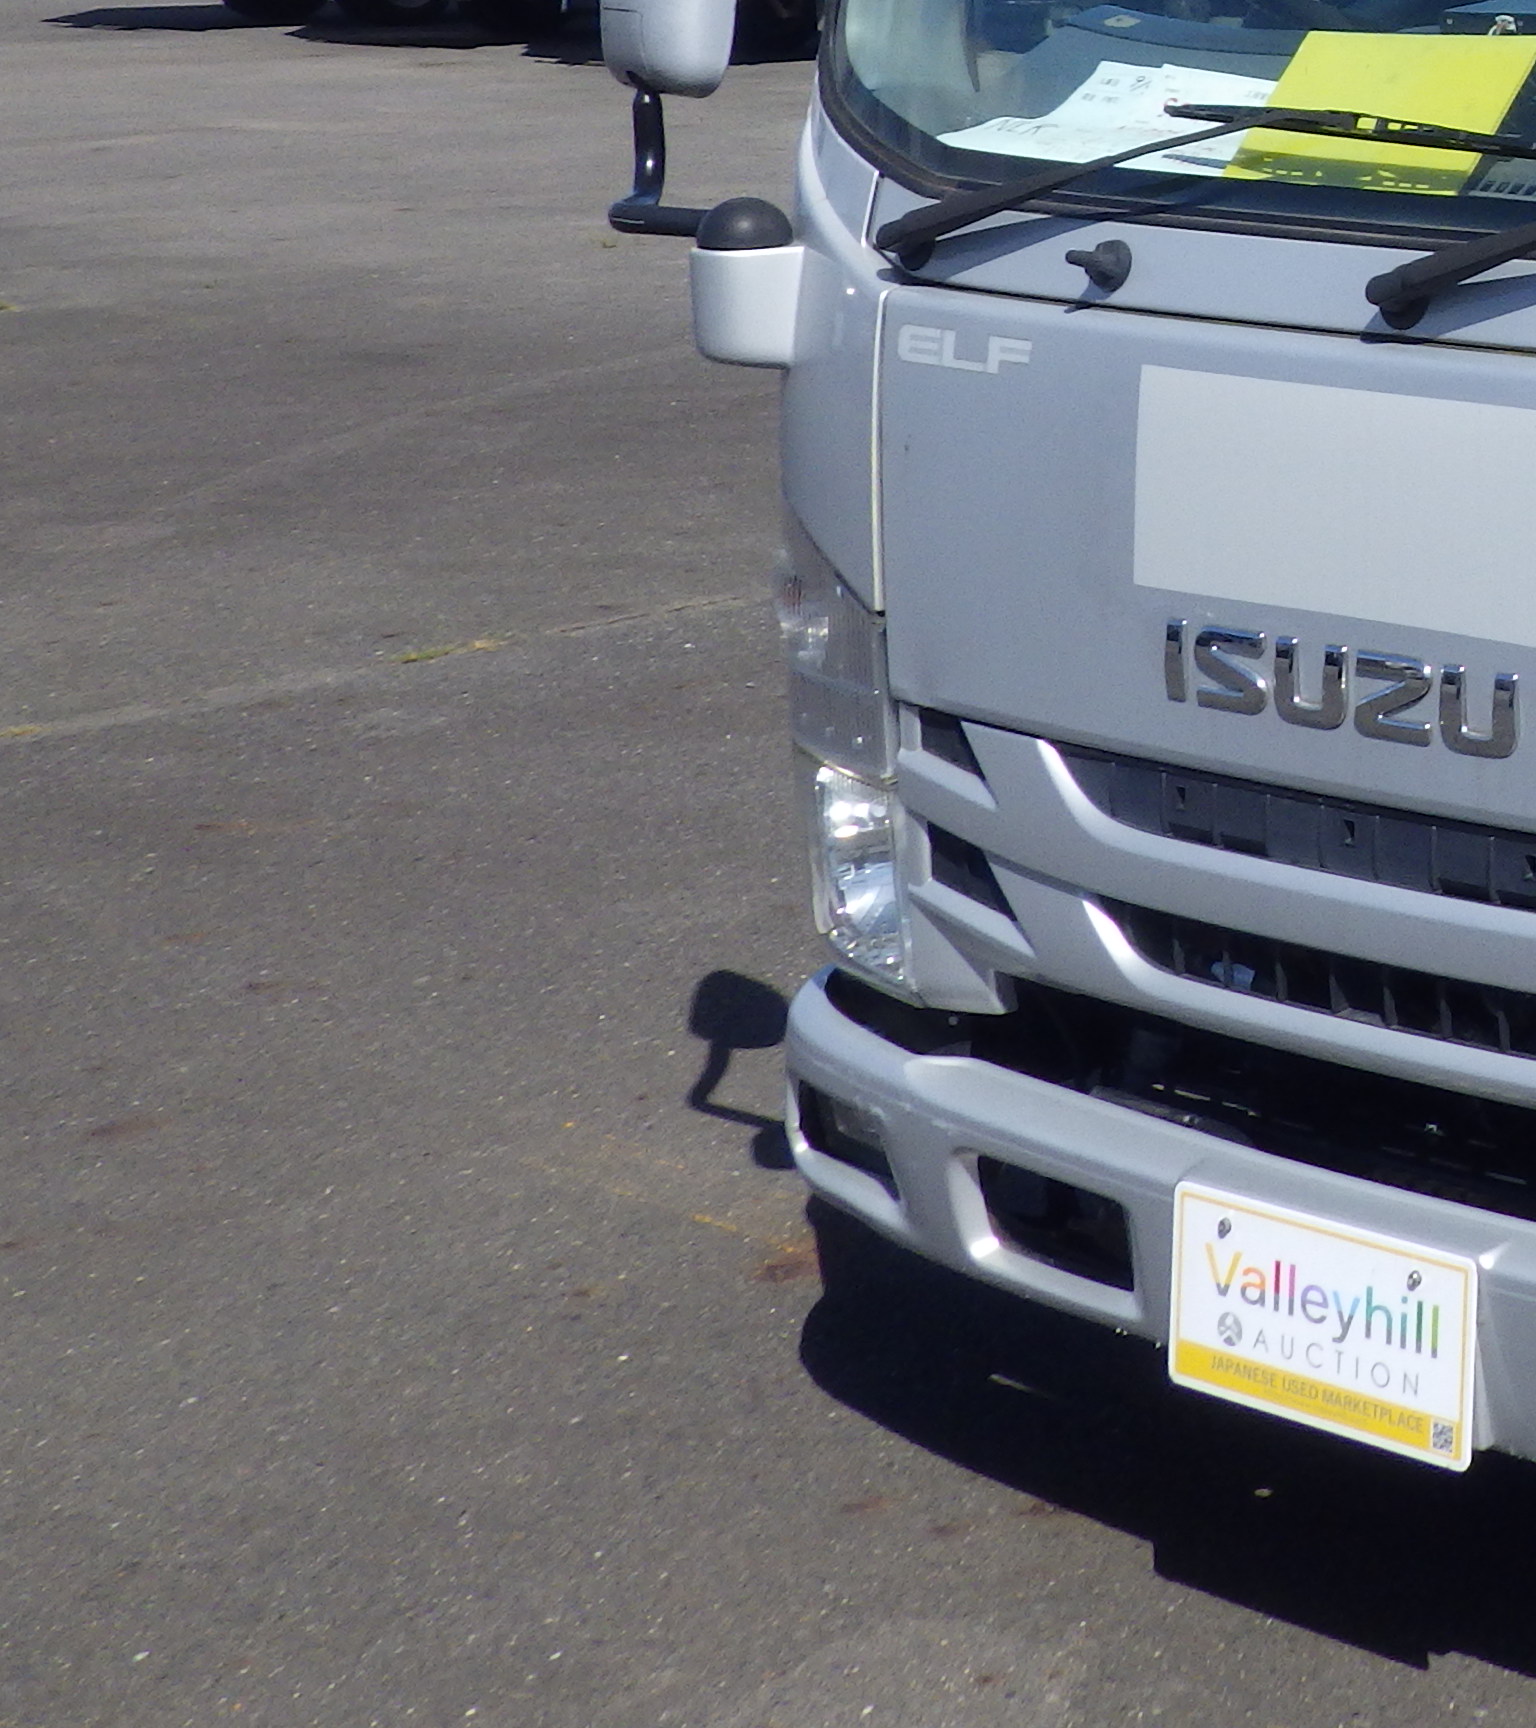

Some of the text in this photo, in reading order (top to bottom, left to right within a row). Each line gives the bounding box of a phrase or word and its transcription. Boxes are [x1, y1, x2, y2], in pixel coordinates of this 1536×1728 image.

[897, 323, 1033, 374] ELF
[1162, 617, 1522, 760] ISUZU
[1205, 1241, 1440, 1359] Valleyhill
[1211, 1355, 1278, 1389] JAPANESE
[1282, 1376, 1319, 1401] USED
[1322, 1388, 1424, 1434] MARKETPLACE
[1253, 1328, 1420, 1398] AUCTION
